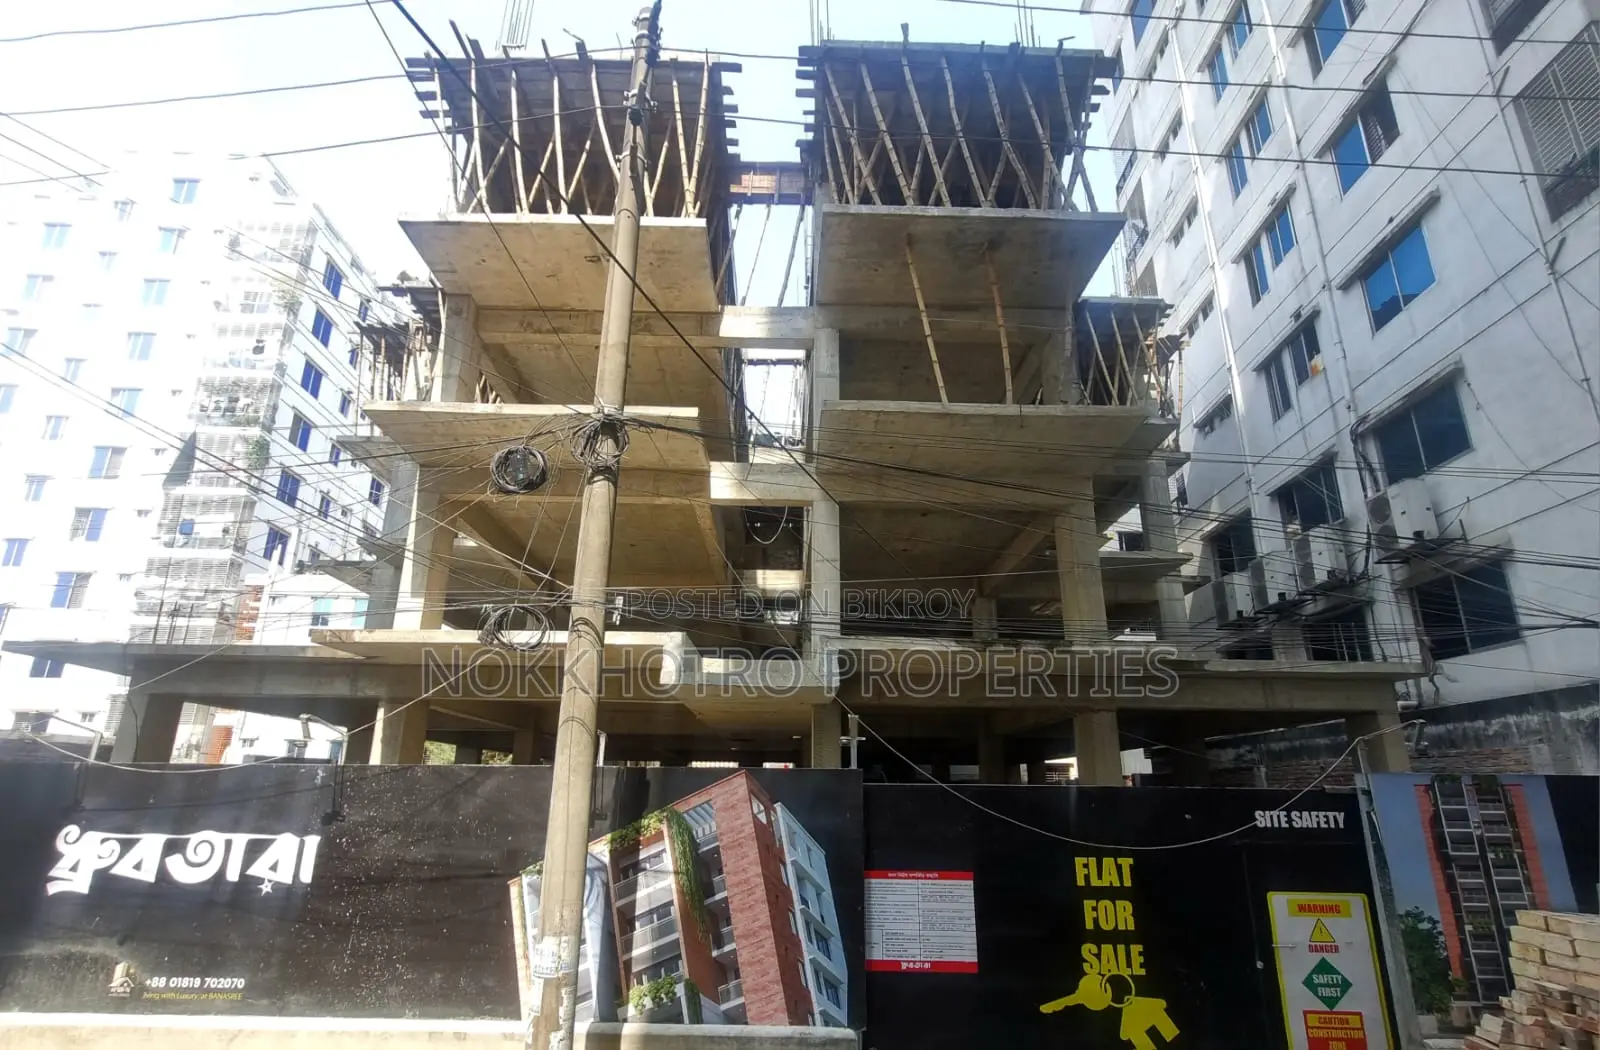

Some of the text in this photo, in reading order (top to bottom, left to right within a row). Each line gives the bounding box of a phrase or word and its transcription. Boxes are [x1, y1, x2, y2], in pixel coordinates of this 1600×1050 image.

[1254, 810, 1345, 829] SITE SAFETY
[45, 824, 322, 897] ধ্রুবতারা
[1074, 857, 1134, 887] FLAT
[1083, 899, 1135, 931] FOR
[1297, 903, 1341, 914] WARNING
[1308, 943, 1340, 953] DANGER
[1081, 943, 1146, 975] SALE
[145, 976, 245, 989] +88 01819 702070
[1312, 974, 1342, 985] SAFETY
[1317, 986, 1341, 997] FIRST
[1307, 1028, 1364, 1039] CONSTRUCTION
